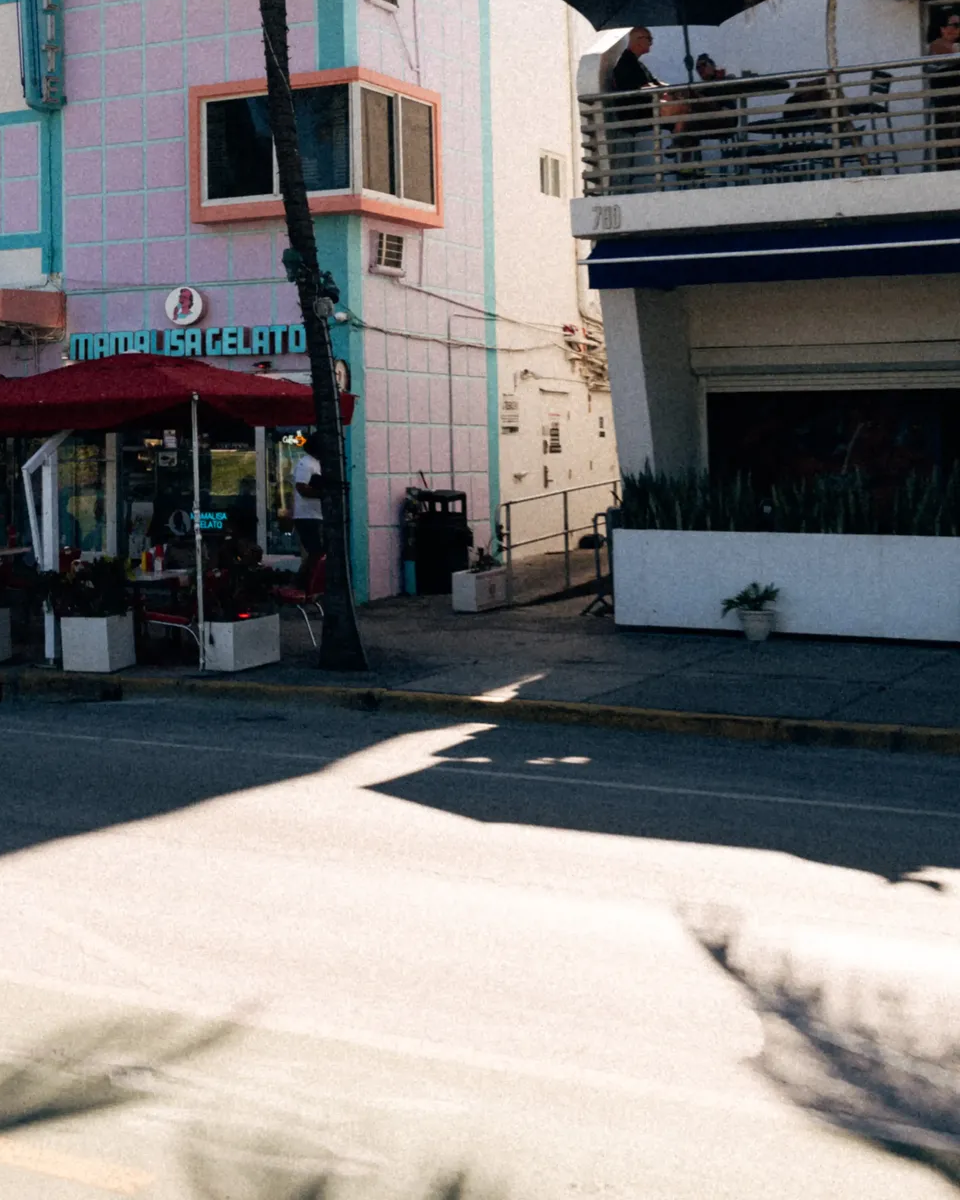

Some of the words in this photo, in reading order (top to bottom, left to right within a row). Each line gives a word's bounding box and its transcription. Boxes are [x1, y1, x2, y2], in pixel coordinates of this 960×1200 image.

[69, 328, 202, 360] MAMALISA
[205, 323, 307, 356] GELATO
[190, 511, 228, 521] MMALISA
[200, 520, 223, 529] ELATO
